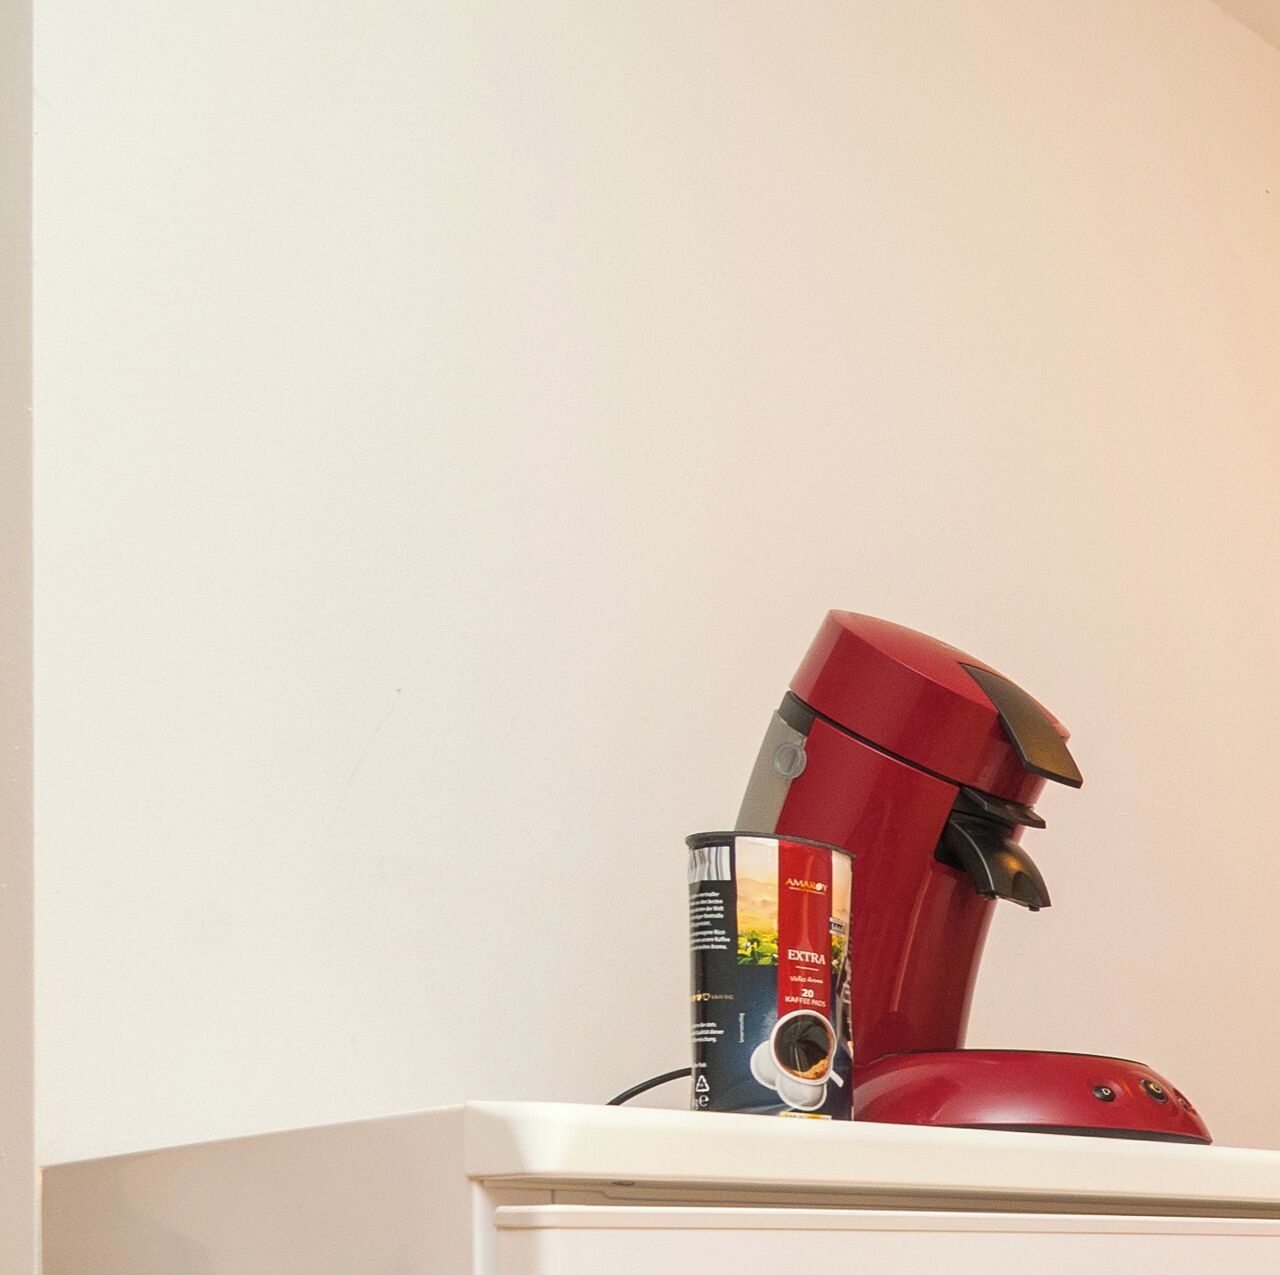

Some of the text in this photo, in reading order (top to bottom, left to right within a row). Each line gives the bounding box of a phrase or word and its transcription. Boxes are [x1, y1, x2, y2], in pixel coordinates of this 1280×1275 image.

[786, 948, 827, 966] EXTRA
[800, 987, 815, 998] 20
[784, 995, 811, 1006] KAFFEE
